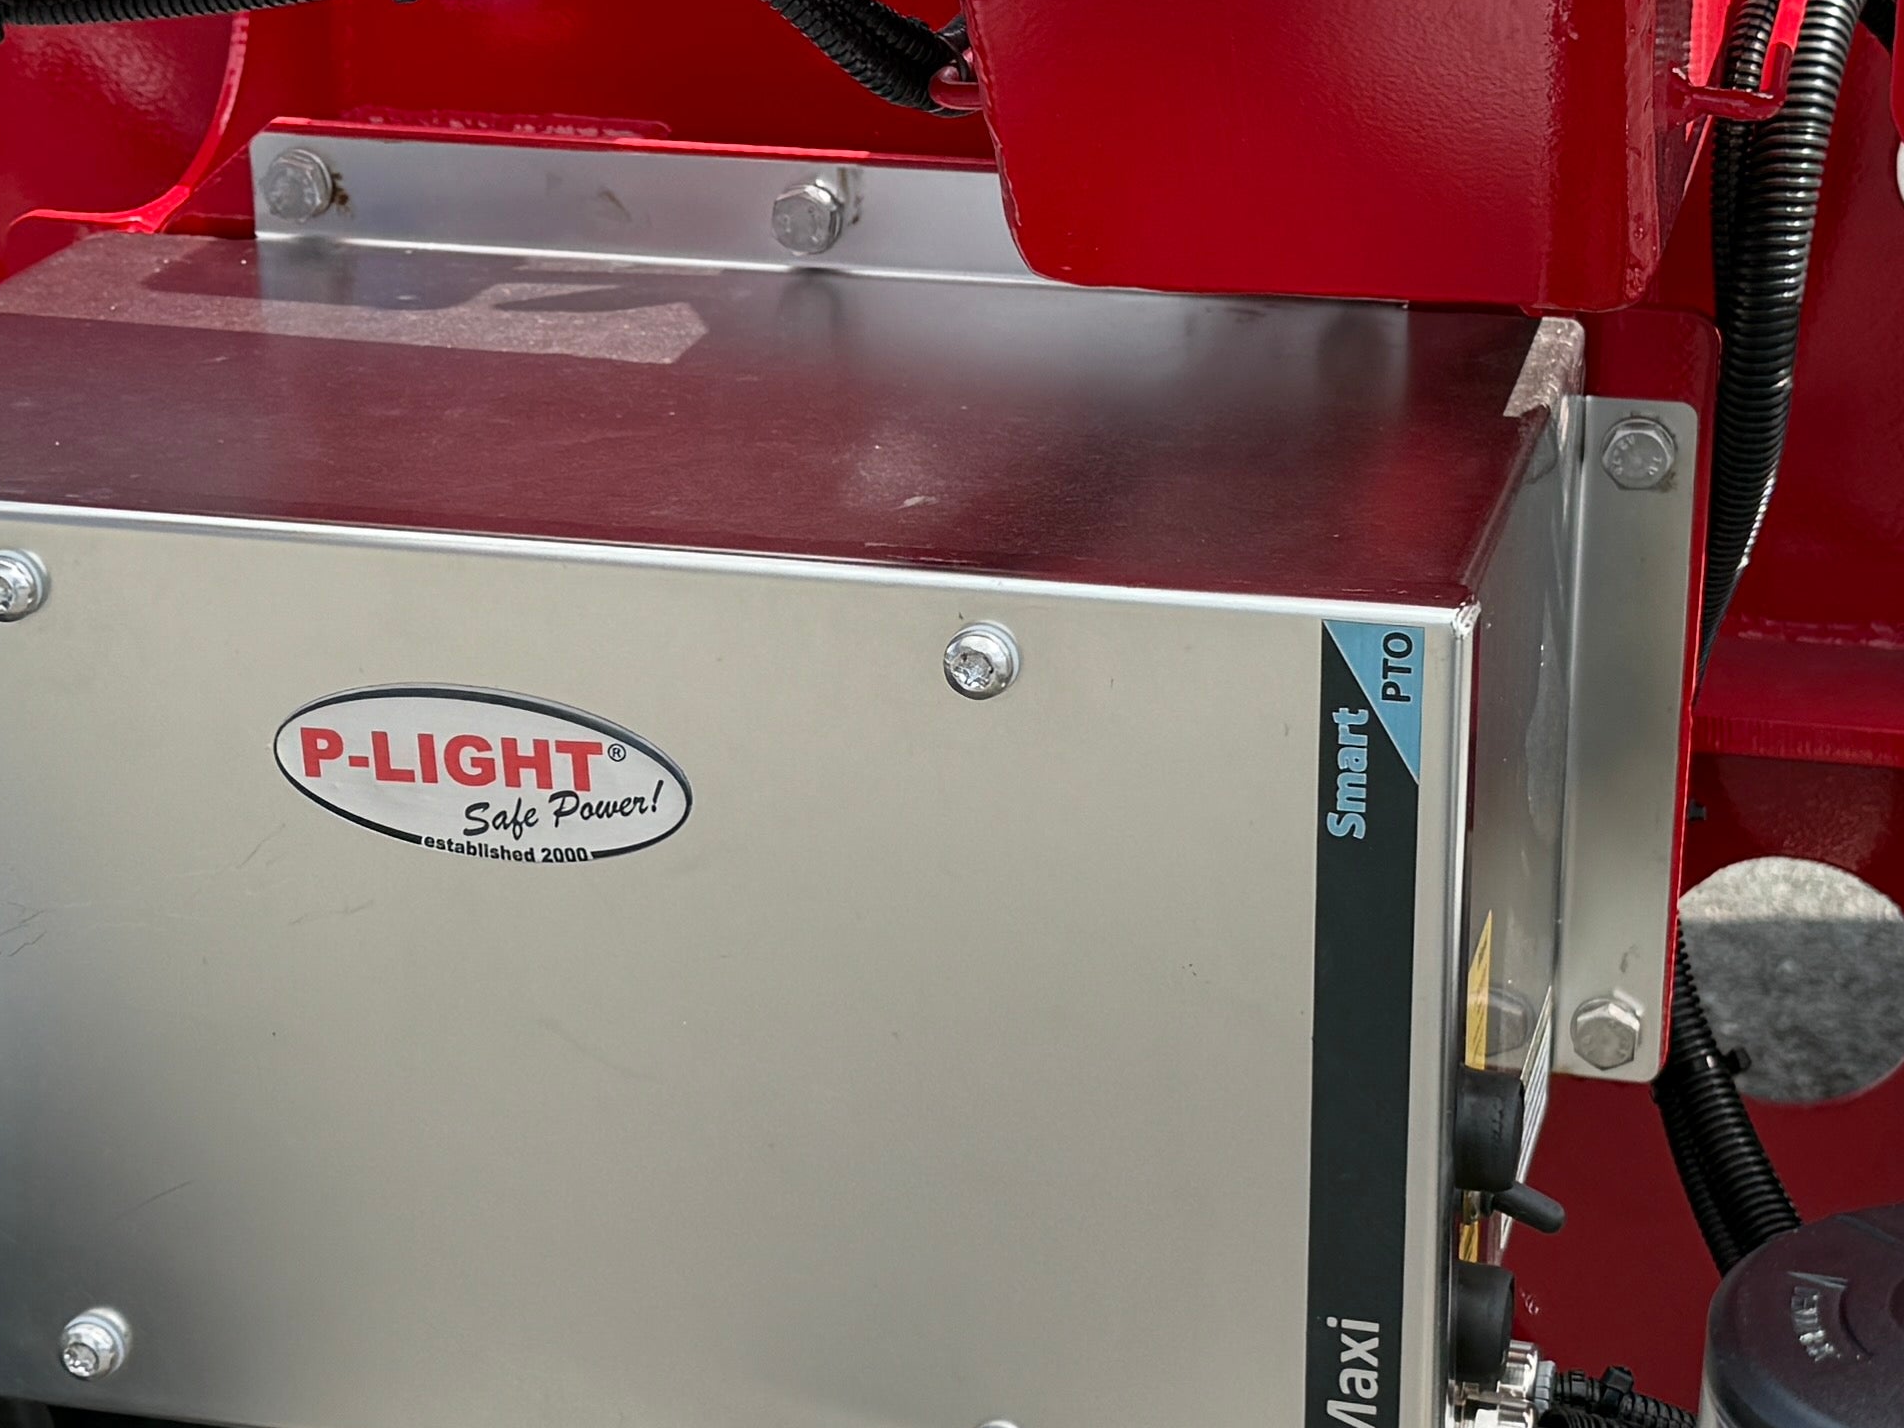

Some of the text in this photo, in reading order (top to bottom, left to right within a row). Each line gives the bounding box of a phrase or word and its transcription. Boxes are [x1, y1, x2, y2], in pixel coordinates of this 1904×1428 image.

[1381, 631, 1414, 703] PTO
[1326, 707, 1370, 840] Smart
[462, 779, 664, 841] Safe Power!
[423, 835, 589, 864] established 2000
